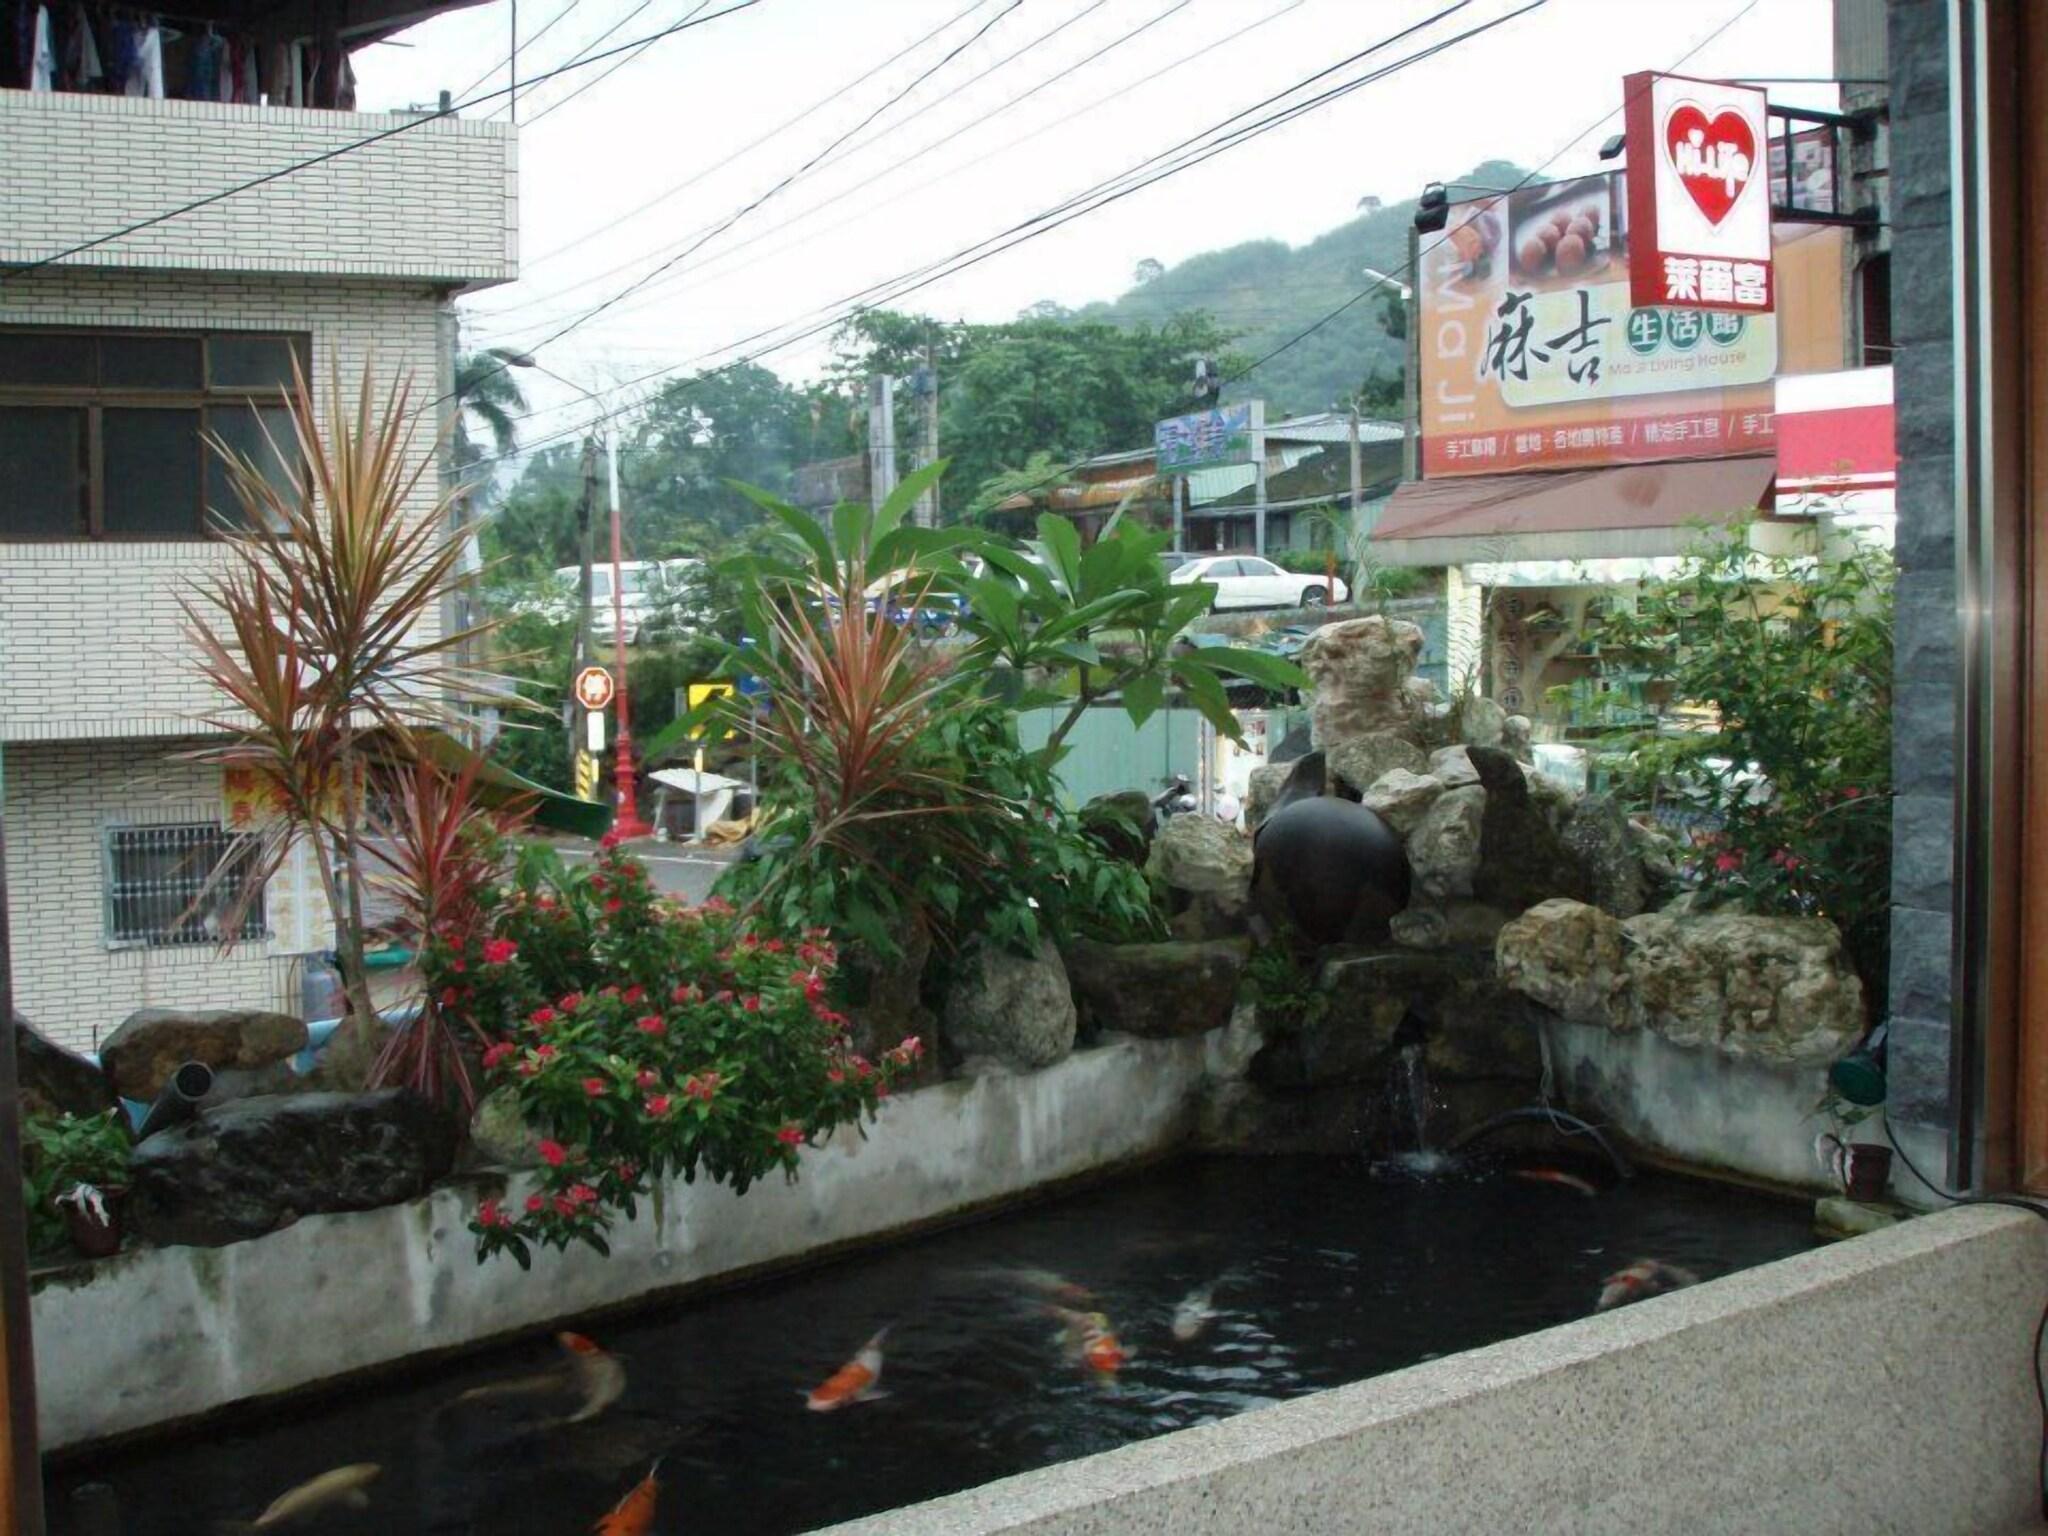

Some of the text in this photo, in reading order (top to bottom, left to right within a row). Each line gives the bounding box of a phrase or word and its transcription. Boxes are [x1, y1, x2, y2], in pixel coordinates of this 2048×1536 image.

[1480, 290, 1612, 384] 麻吉
[1631, 311, 1738, 347] 生活館
